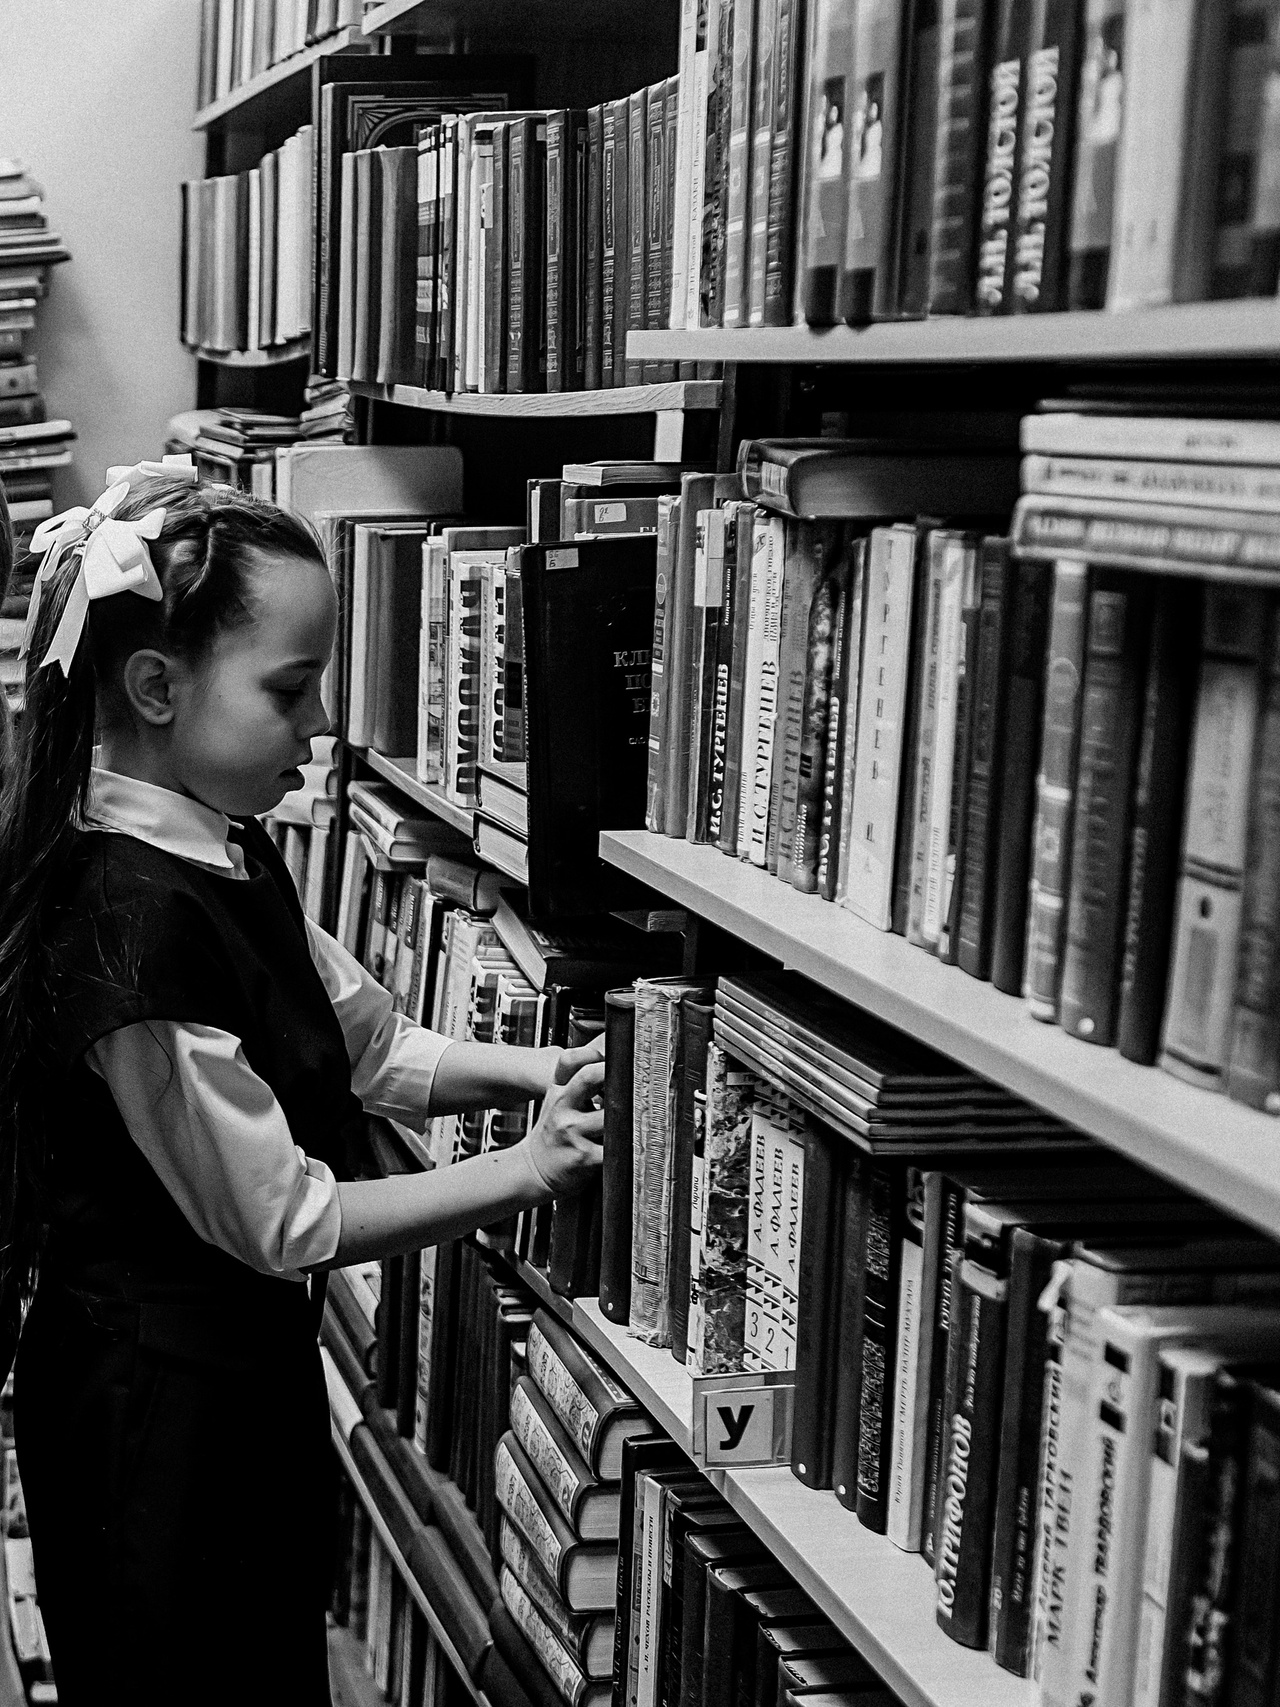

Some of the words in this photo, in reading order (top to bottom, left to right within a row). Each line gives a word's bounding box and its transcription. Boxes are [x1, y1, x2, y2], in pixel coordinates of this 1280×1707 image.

[691, 177, 699, 221] КАЗАКИ
[712, 663, 729, 782] ТУРГЕНЕВ
[753, 661, 777, 794] ТУРГЕНЕВ
[782, 670, 803, 810] ТУРГЕНЕВ
[709, 788, 723, 835] И.С.
[753, 1134, 765, 1219] ФАДЕЕВ
[770, 1147, 784, 1233] ФАДЕЕВ
[788, 1163, 800, 1248] ФАДЕЕВ
[753, 1223, 762, 1243] А.
[770, 1238, 779, 1258] А.
[750, 1311, 759, 1339] 3
[765, 1327, 775, 1355] 2
[716, 1405, 756, 1450] У
[1043, 1364, 1063, 1510] ТАРКОВСКИЙ
[893, 1476, 903, 1505] Юрий
[1053, 1469, 1074, 1550] ТВЕН
[1046, 1565, 1066, 1649] МАРК
